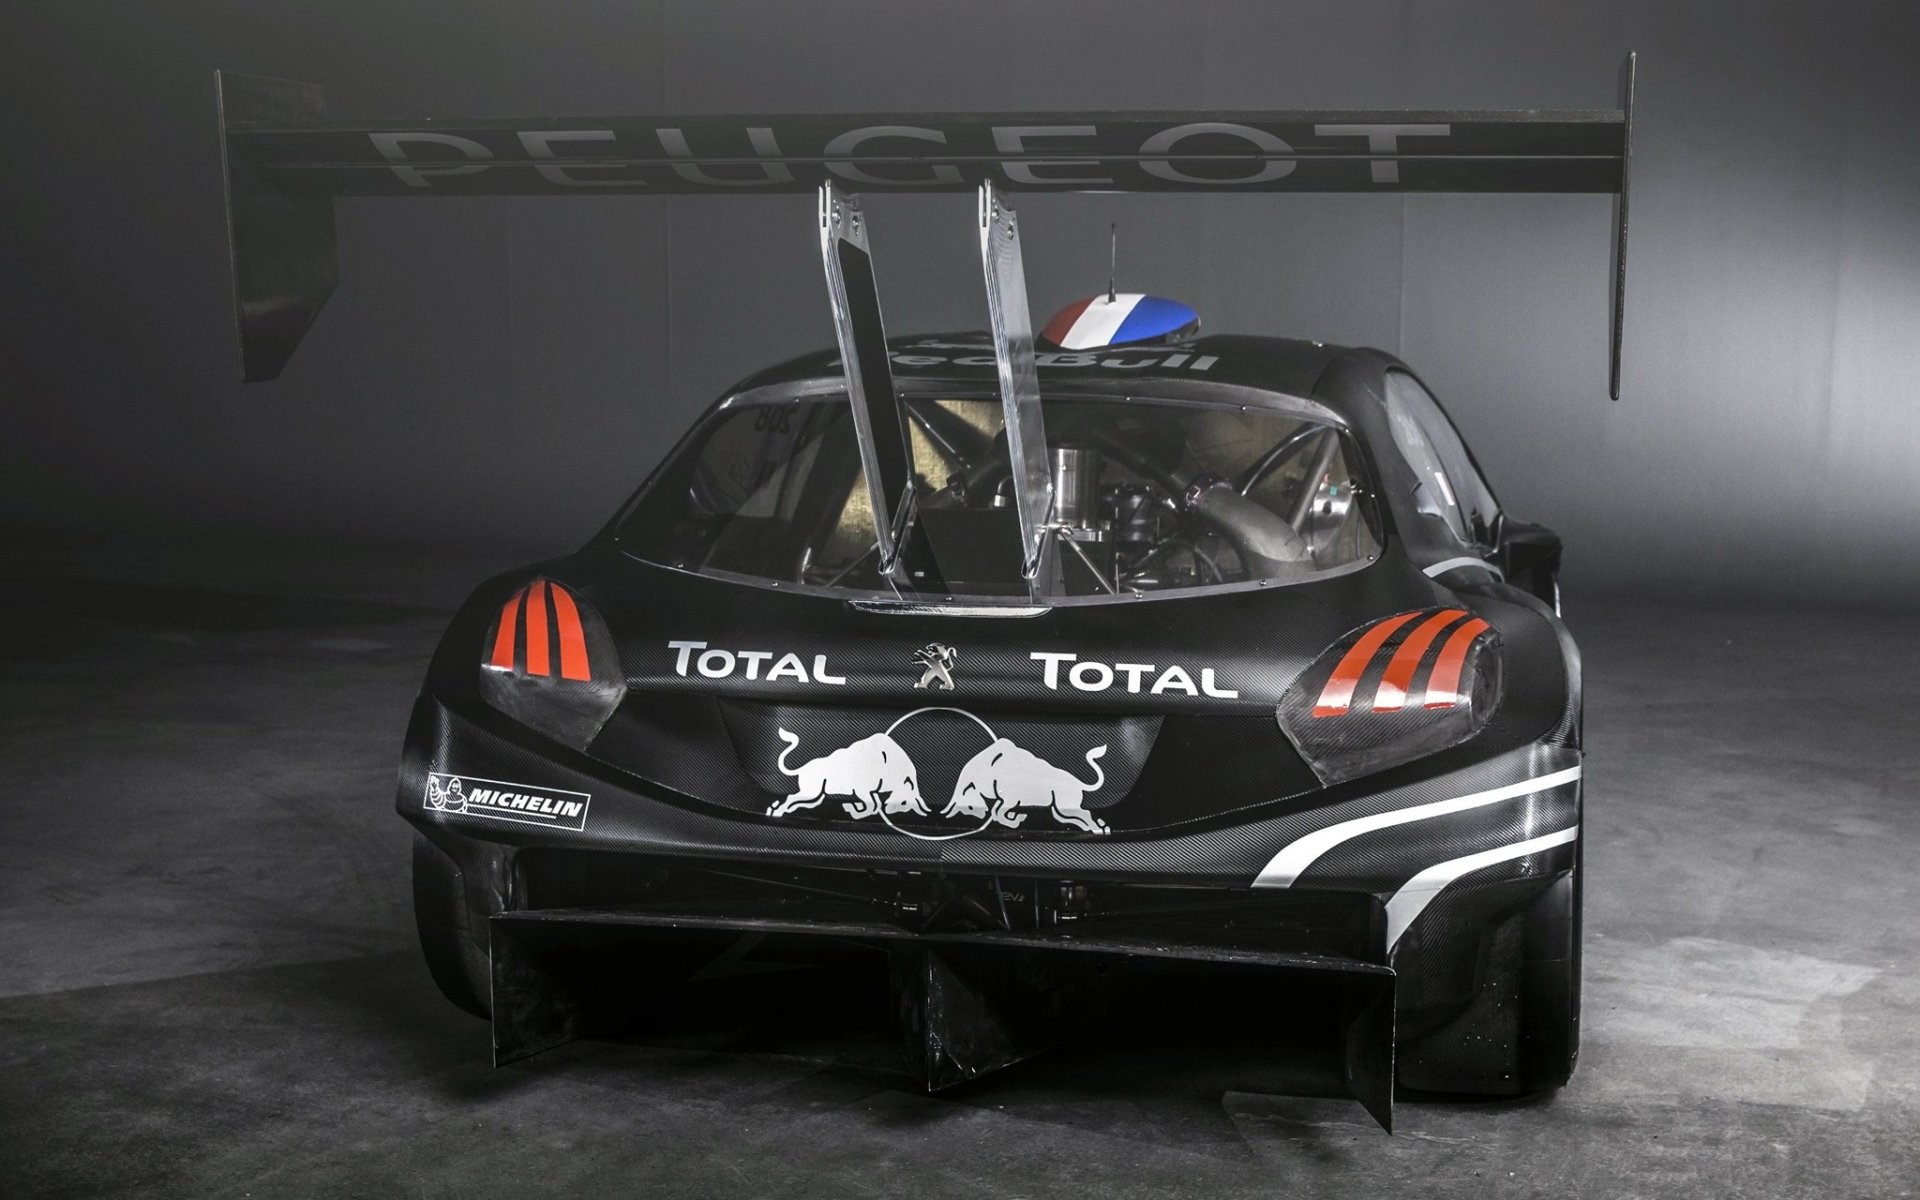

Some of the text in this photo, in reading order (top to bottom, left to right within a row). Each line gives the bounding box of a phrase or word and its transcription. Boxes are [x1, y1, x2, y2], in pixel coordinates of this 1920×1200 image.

[368, 122, 1452, 189] PEUGEOT
[1034, 353, 1220, 371] Bull
[668, 640, 846, 685] TOTAL
[1030, 652, 1238, 698] TOTAL
[468, 788, 584, 818] MICHELIN
